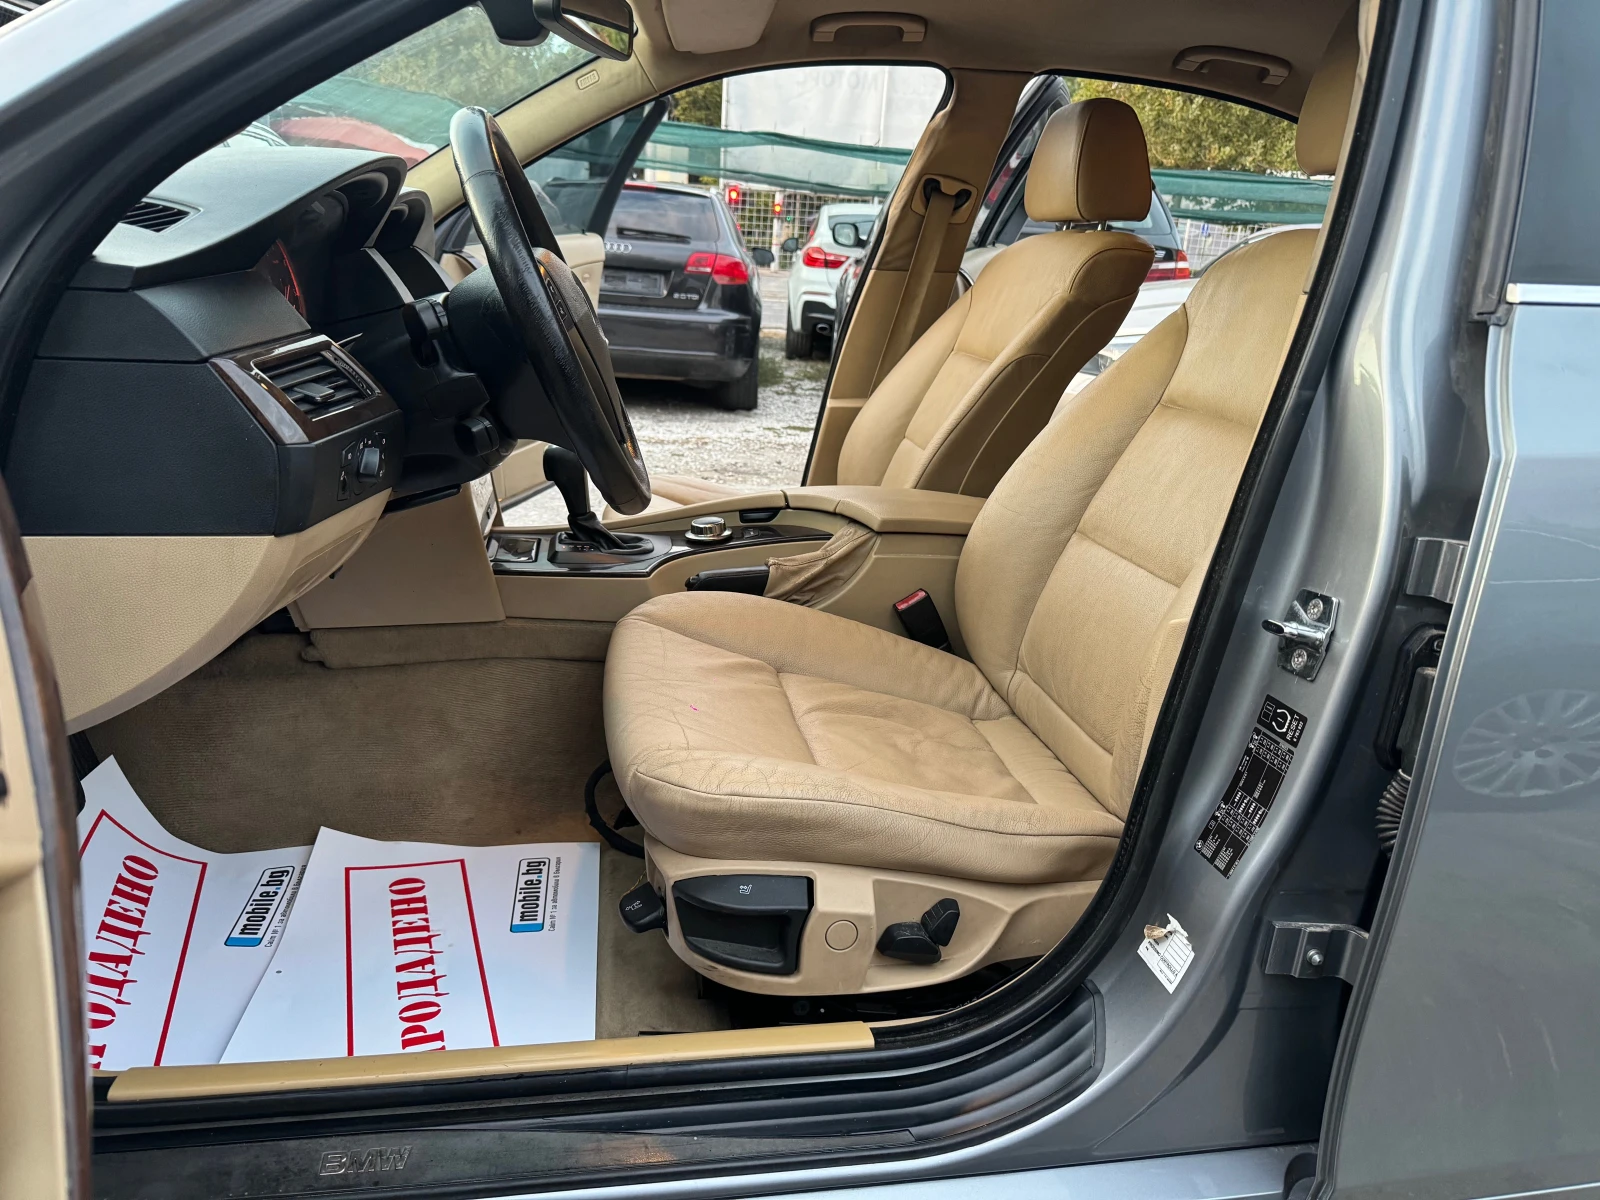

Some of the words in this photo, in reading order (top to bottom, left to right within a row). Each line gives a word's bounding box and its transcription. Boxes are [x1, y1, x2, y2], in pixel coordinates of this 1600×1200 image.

[1286, 714, 1300, 741] RESET
[238, 870, 290, 936] mobile.bg
[518, 860, 547, 922] mobile.bg
[388, 877, 450, 1051] РОДАДЕНО
[320, 1145, 413, 1175] BMW
